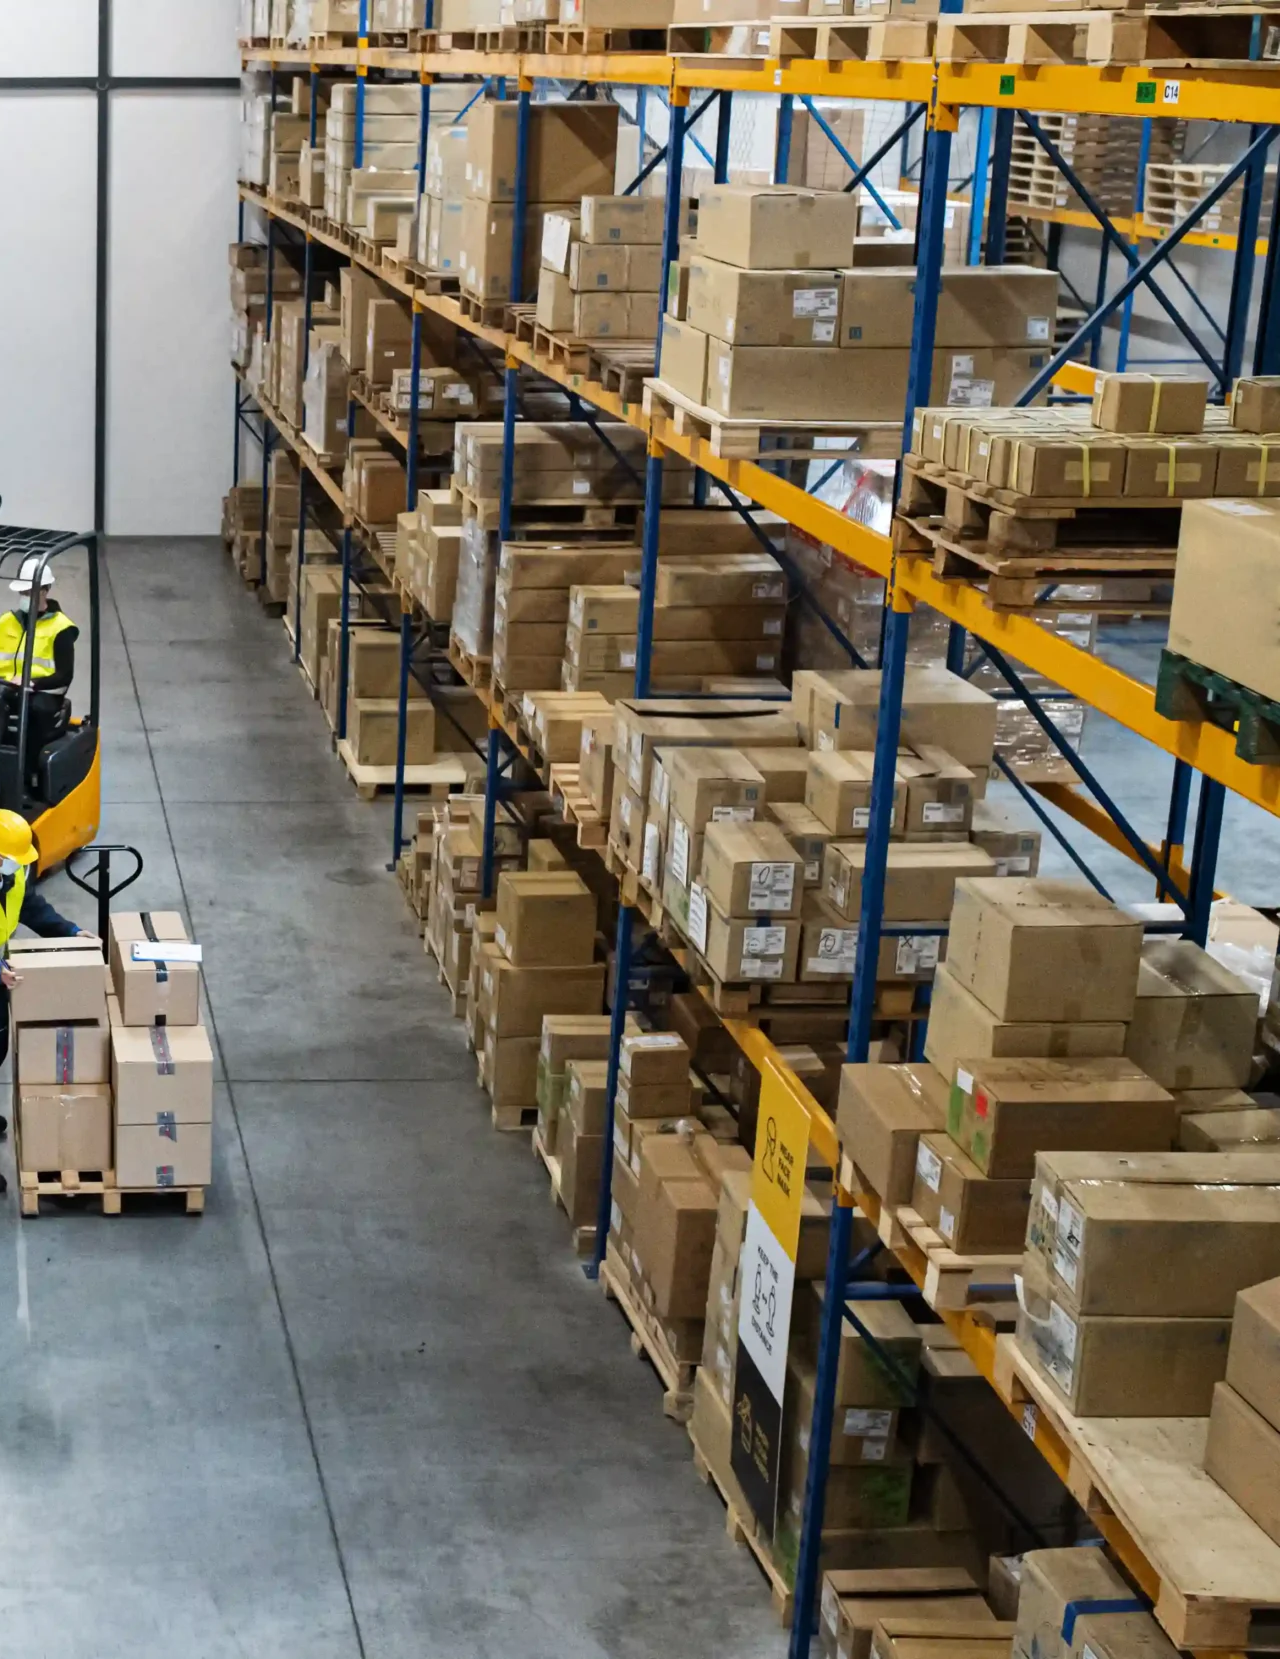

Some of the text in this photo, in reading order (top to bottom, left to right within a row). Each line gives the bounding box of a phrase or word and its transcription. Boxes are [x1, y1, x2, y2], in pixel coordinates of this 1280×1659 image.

[1164, 85, 1179, 99] C14
[780, 1141, 794, 1167] WEAR
[778, 1156, 791, 1182] FACE
[777, 1172, 790, 1198] MASK
[758, 1245, 778, 1283] KEEP THE
[751, 1315, 772, 1356] DISTANCE
